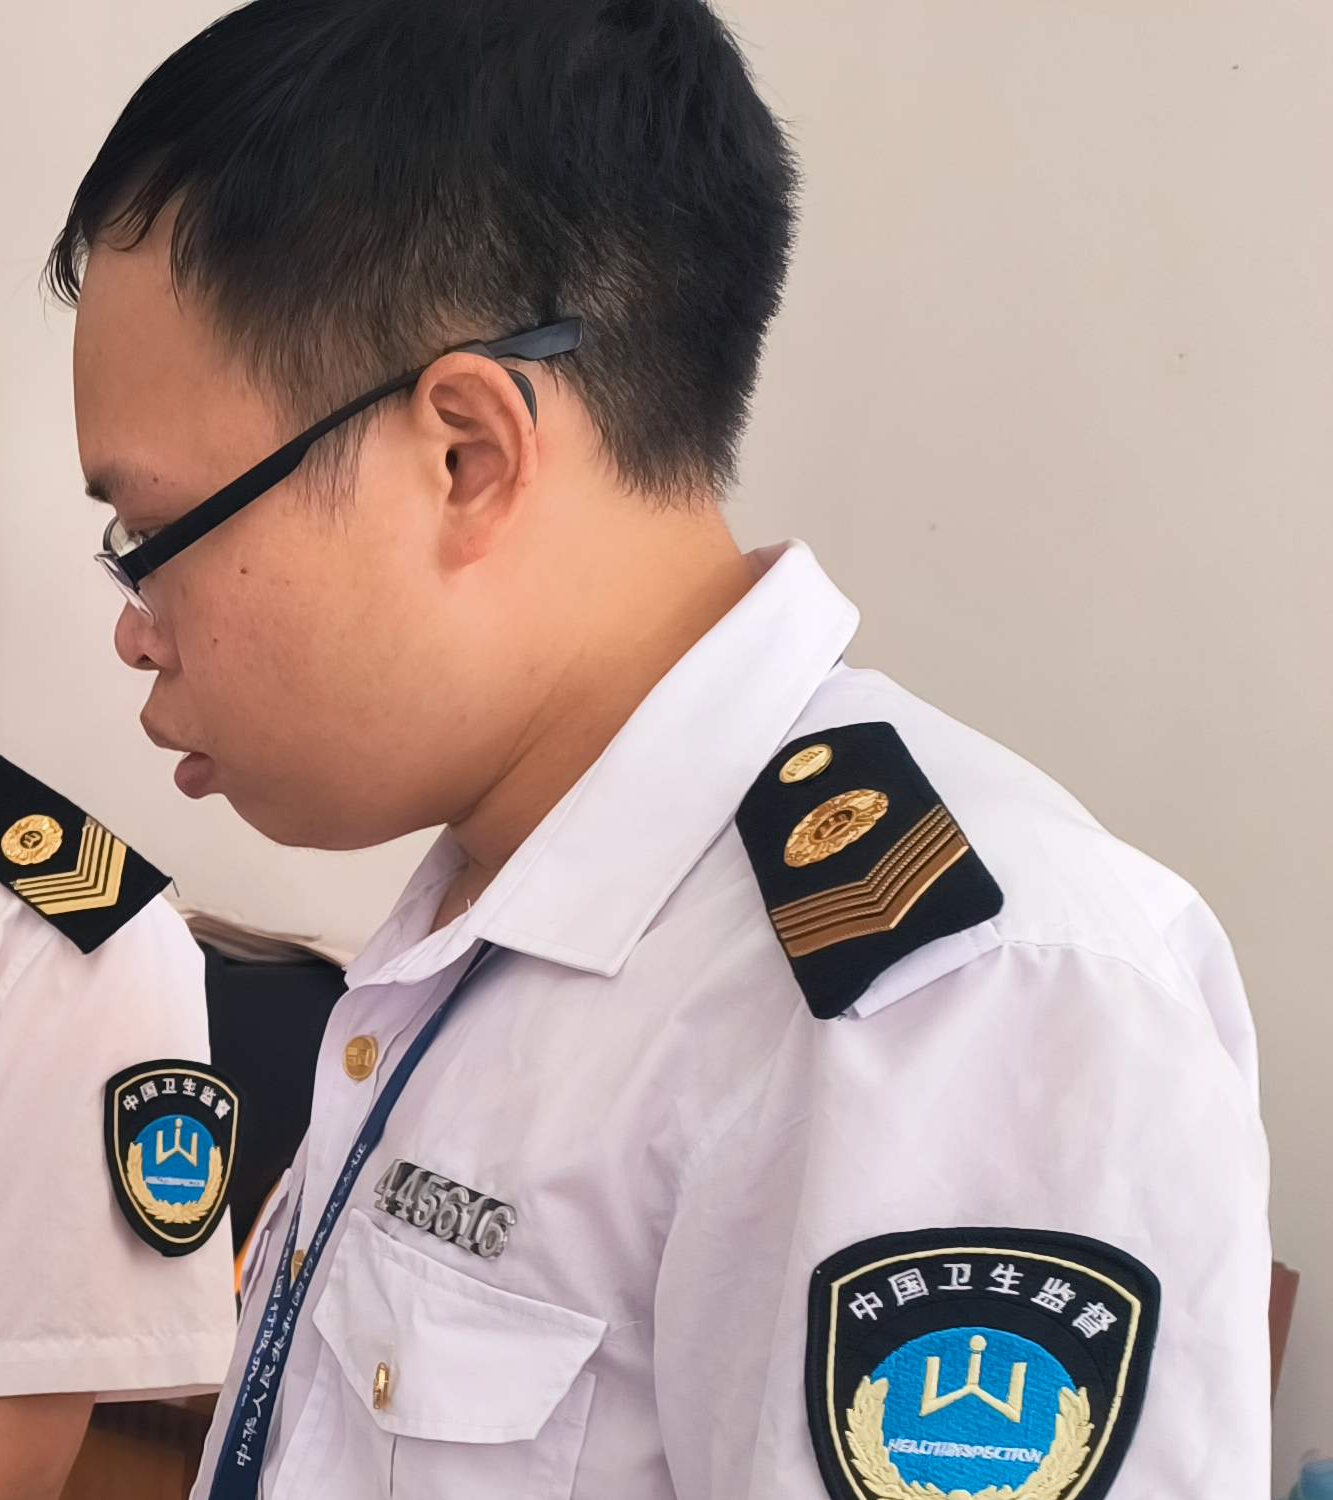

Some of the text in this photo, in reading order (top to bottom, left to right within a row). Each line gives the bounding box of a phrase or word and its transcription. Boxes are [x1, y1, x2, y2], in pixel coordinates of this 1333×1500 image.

[122, 1077, 232, 1120] 中国卫生监督
[374, 1159, 517, 1260] 445616
[848, 1262, 1118, 1339] 中国卫生监督
